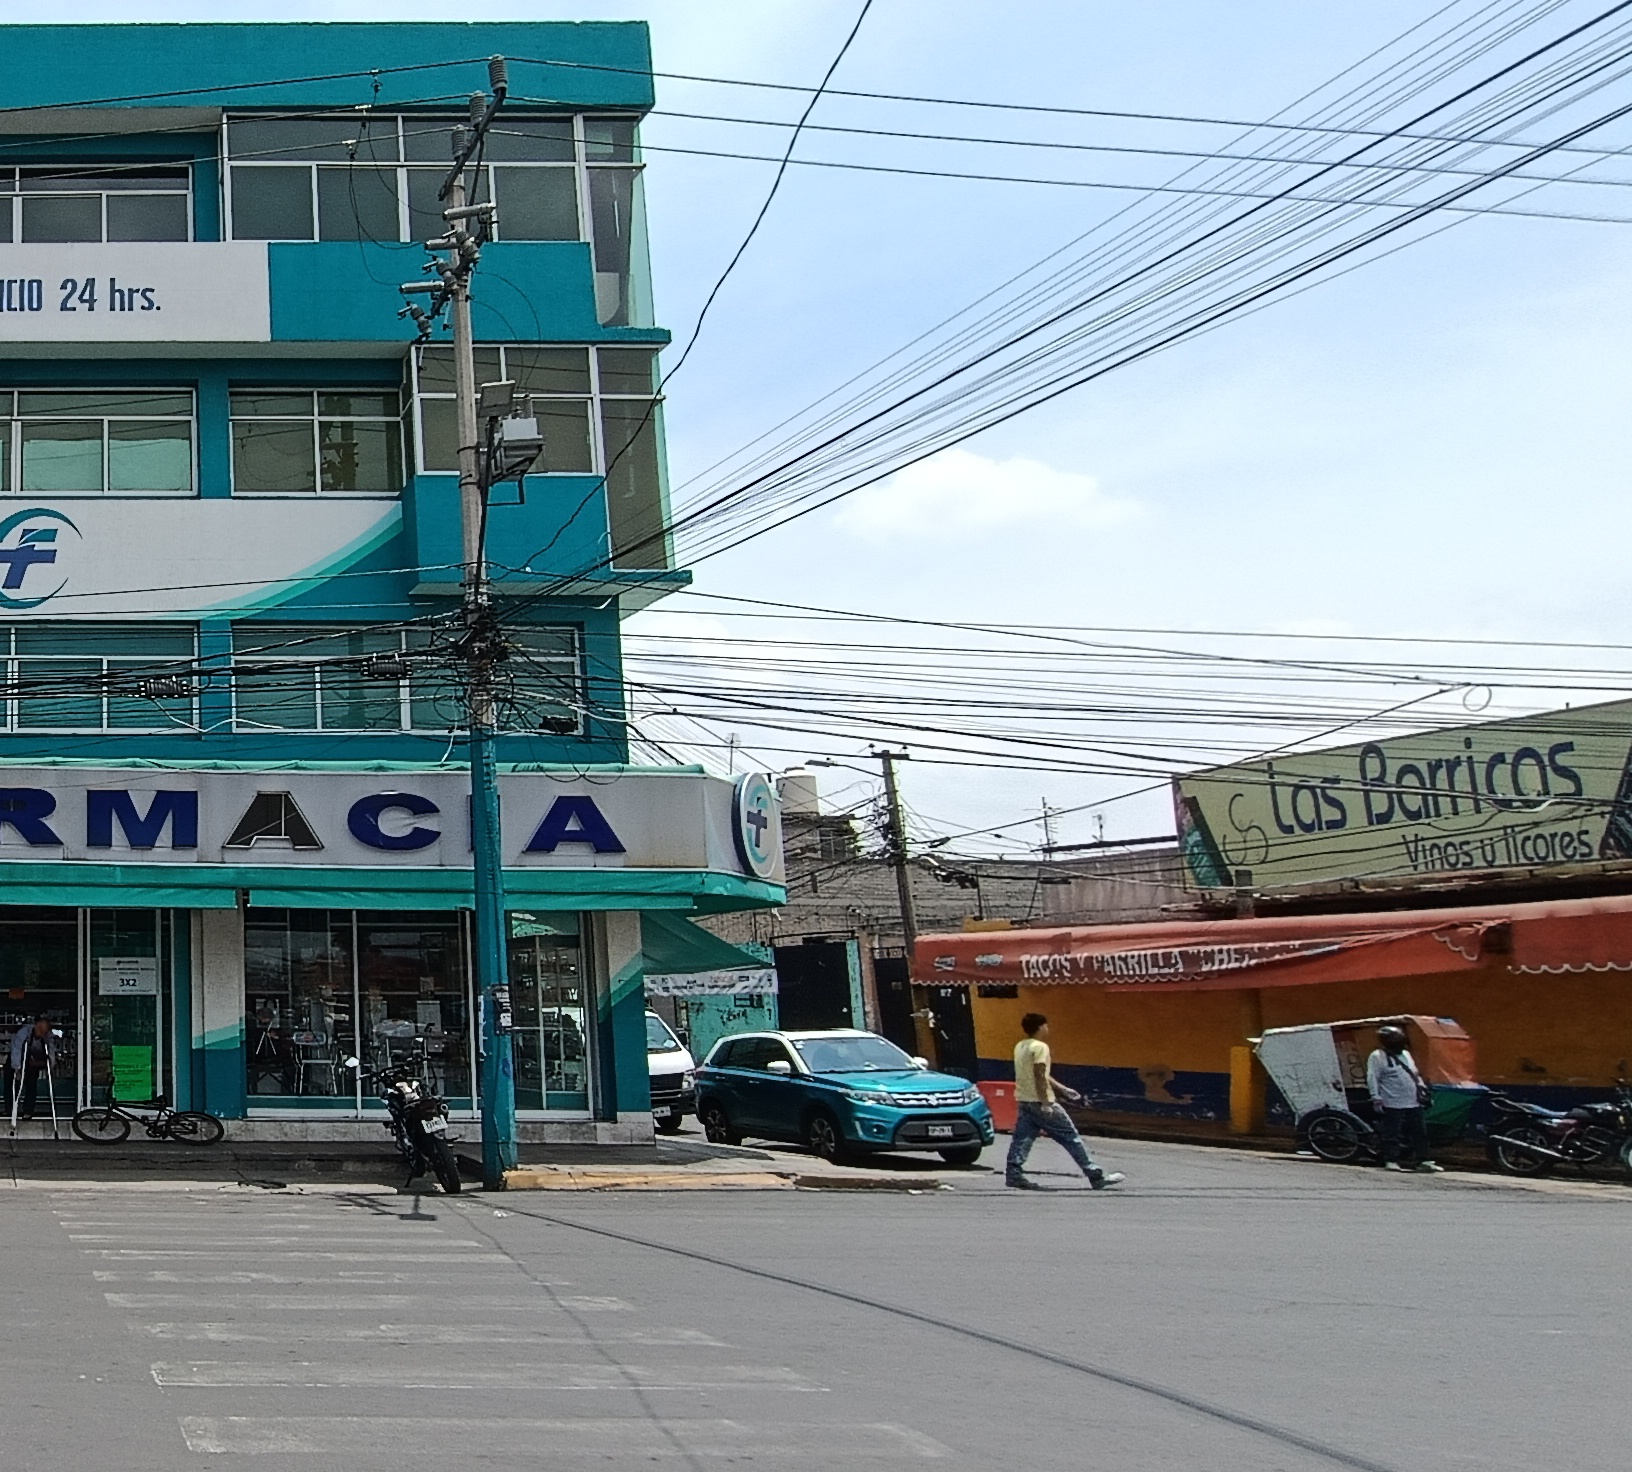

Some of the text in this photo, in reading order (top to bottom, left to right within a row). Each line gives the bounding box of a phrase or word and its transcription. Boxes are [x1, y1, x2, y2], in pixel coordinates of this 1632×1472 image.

[59, 278, 98, 313] 24
[109, 277, 162, 313] hrs.
[1266, 736, 1583, 835] Las Barricas
[1401, 832, 1474, 872] Vinos
[1502, 824, 1594, 865] licores
[119, 978, 137, 987] 3X2
[1019, 953, 1071, 978] TACOS
